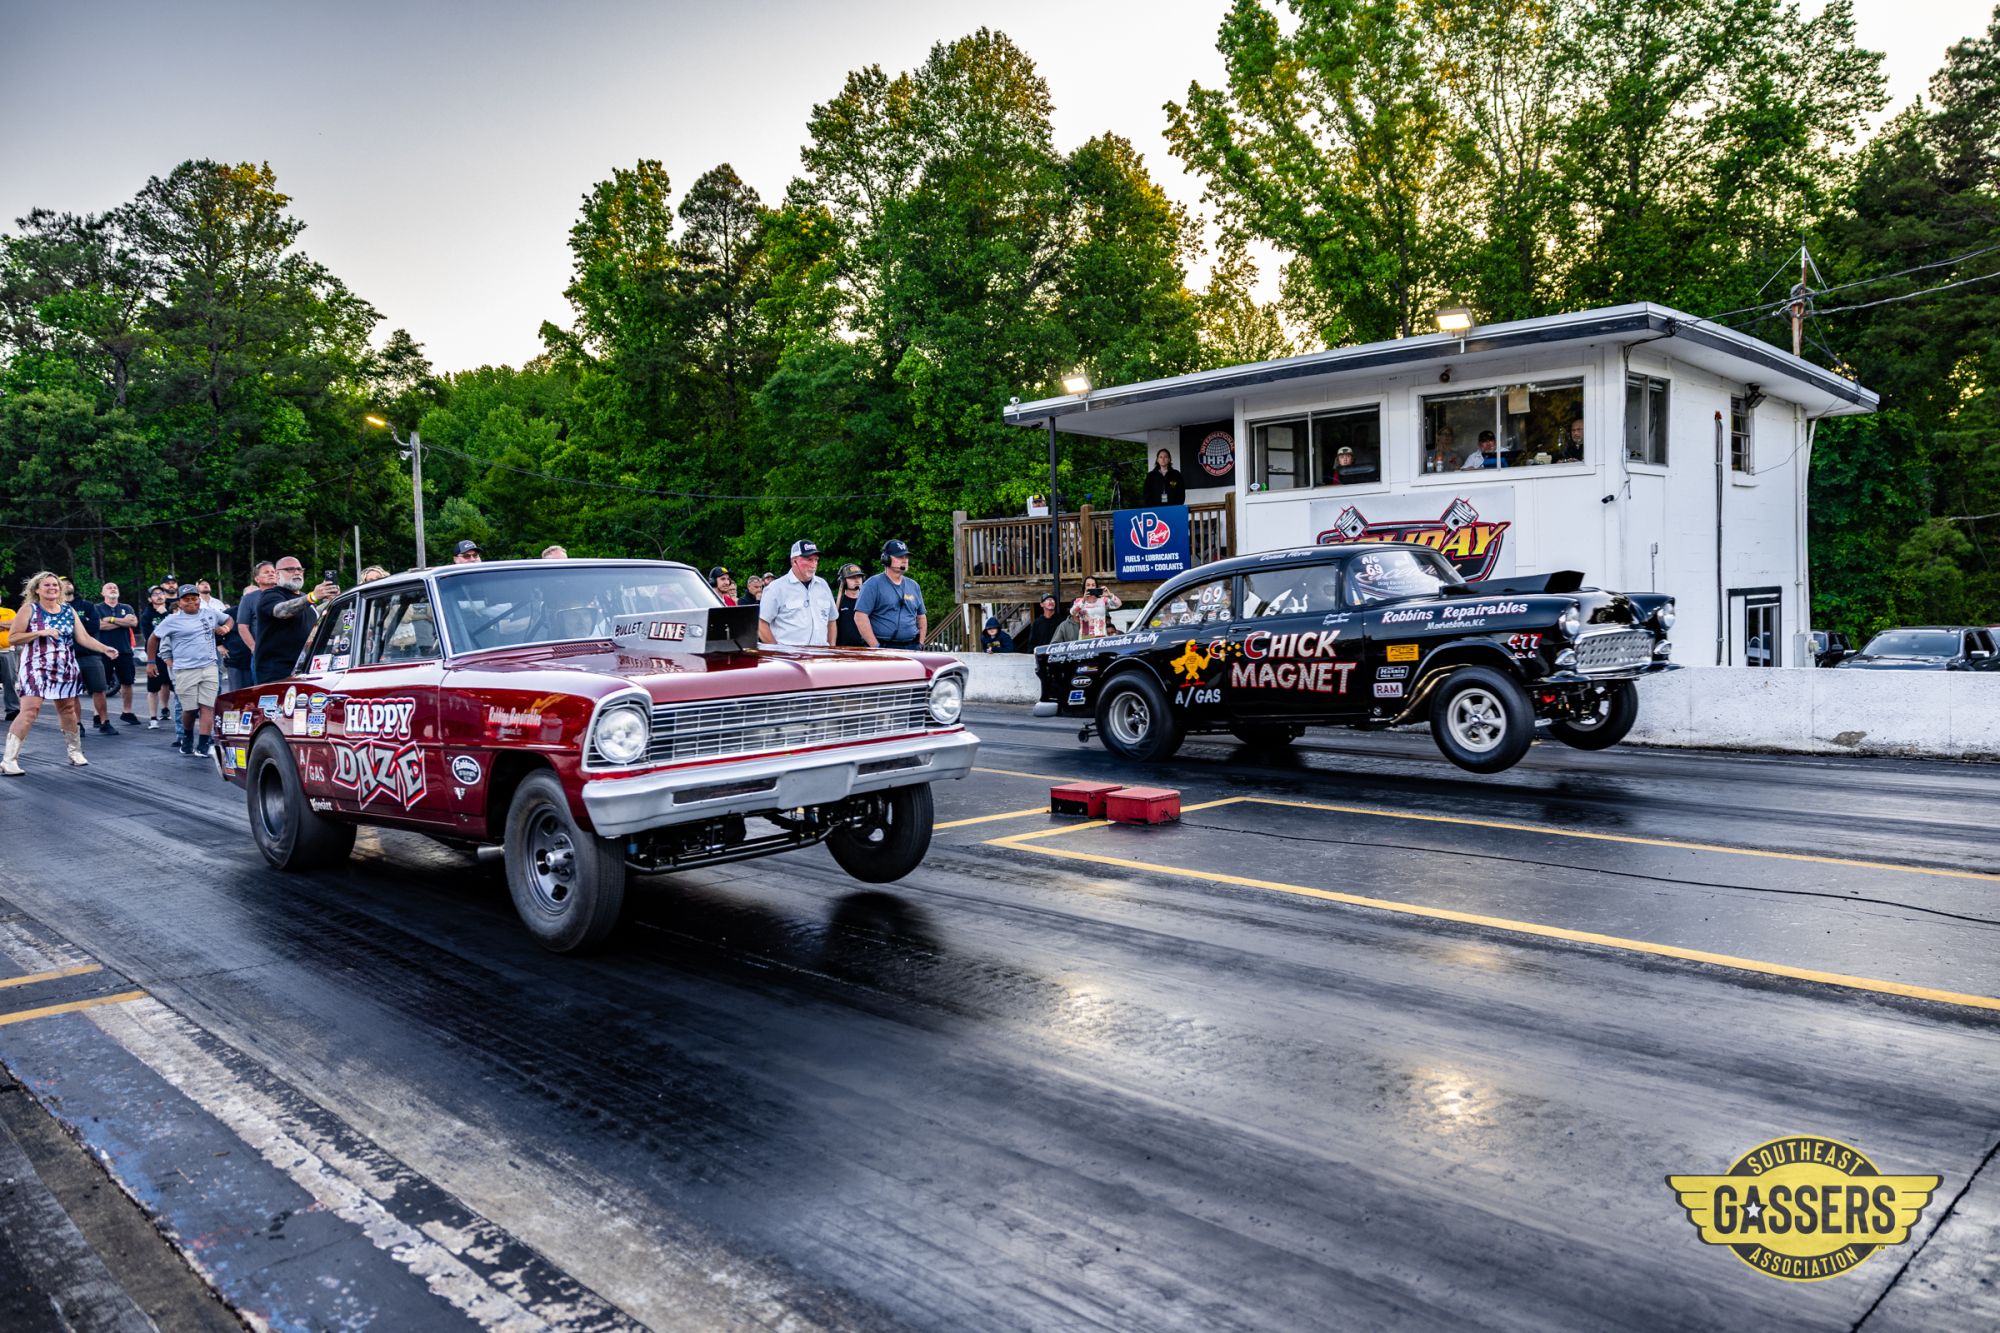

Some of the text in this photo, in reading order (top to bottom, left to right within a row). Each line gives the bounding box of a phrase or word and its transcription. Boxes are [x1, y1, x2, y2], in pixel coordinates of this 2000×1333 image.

[1202, 453, 1234, 465] IHRA
[1130, 512, 1159, 549] VP
[1122, 562, 1184, 573] ADDITIVES COOLANTS
[1124, 552, 1179, 563] FUELS LUBRICANTS
[1366, 564, 1384, 576] 69
[1202, 586, 1222, 604] 69
[1381, 602, 1528, 624] Robbins Repairables
[614, 621, 687, 641] BULLET LINE
[1046, 633, 1159, 654] Leslie Horne & Associates Realty
[1244, 630, 1341, 659] CHICK
[1507, 633, 1543, 650] 477
[1231, 662, 1357, 694] MAGNET
[1376, 684, 1400, 694] RAM
[344, 699, 415, 737] HAPPY
[333, 742, 425, 804] DAZE
